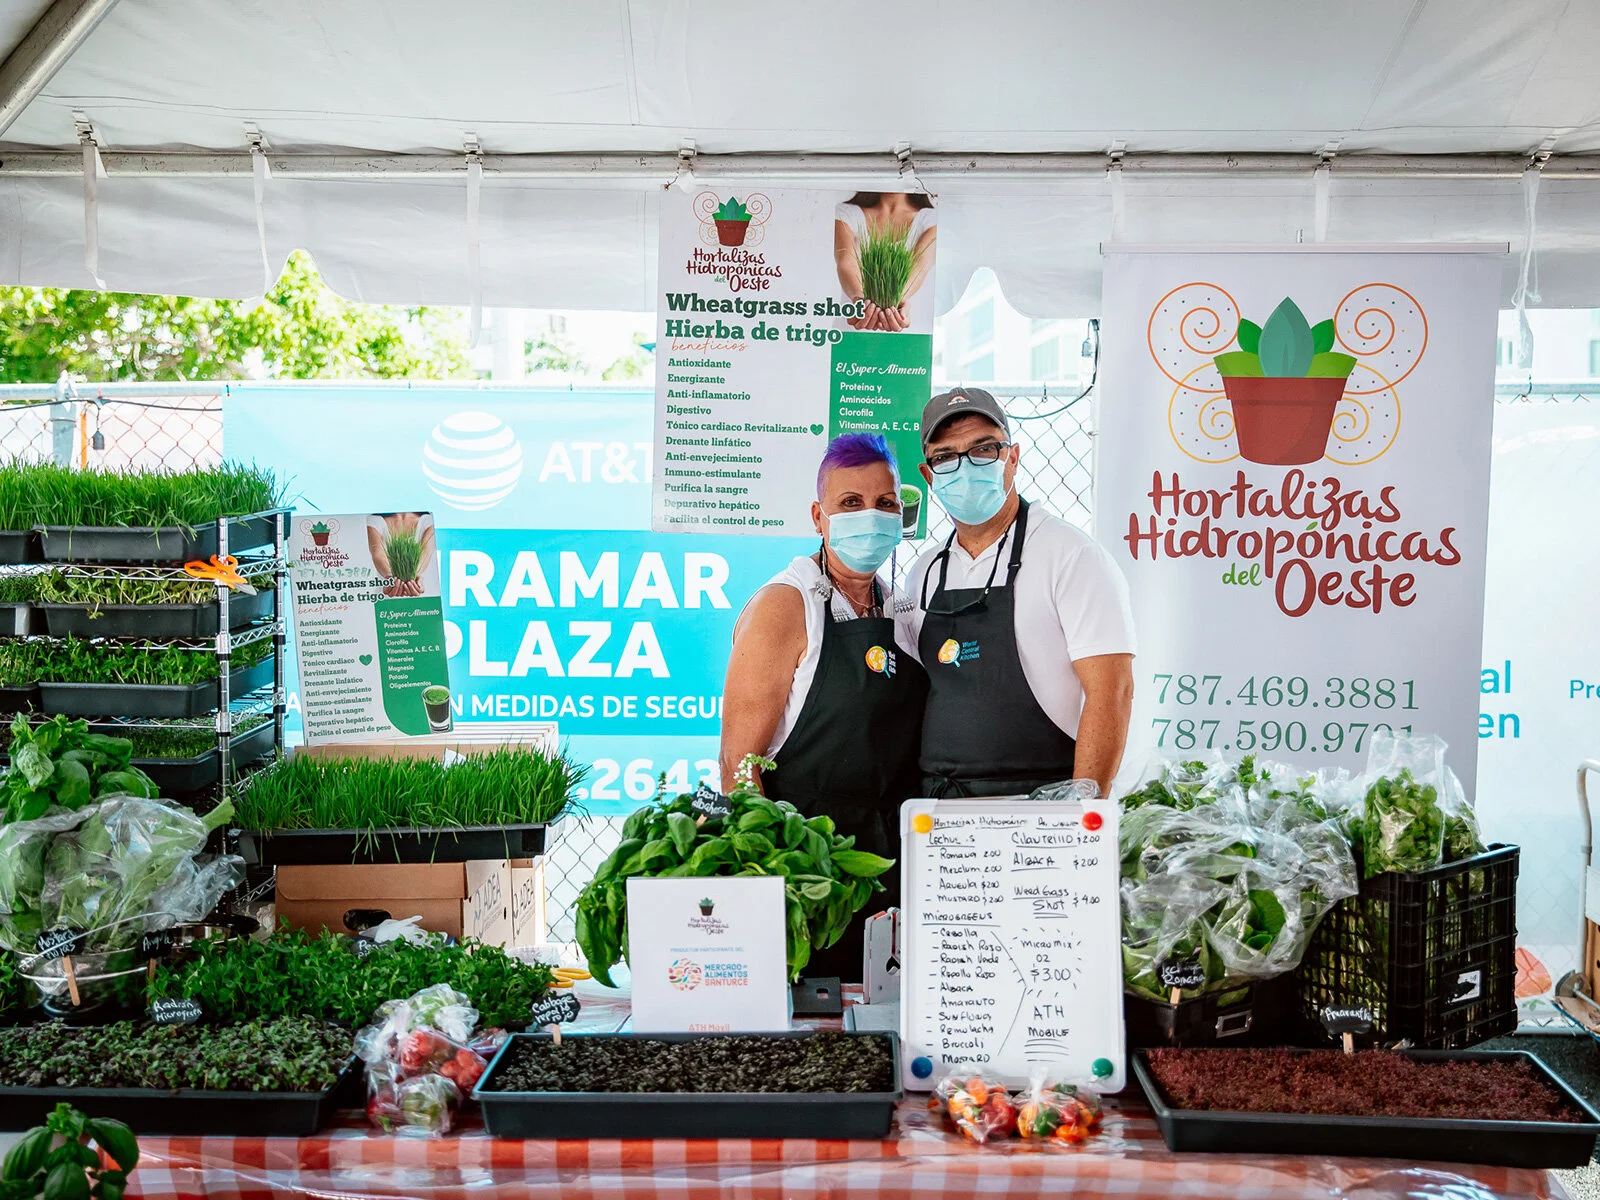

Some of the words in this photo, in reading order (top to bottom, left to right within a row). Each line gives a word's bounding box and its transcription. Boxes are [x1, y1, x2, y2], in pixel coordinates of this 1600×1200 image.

[693, 248, 765, 266] Hortalizas
[686, 260, 782, 280] Hidropónicas
[730, 275, 770, 293] Oeste
[666, 293, 808, 319] Wheatgrass
[814, 298, 864, 318] shot
[665, 319, 745, 340] Hierba
[751, 321, 780, 341] de
[786, 323, 843, 347] trigo
[671, 336, 748, 354] beneficios
[668, 358, 731, 369] Antioxidante
[836, 362, 846, 373] El
[846, 363, 877, 377] Super
[878, 364, 927, 375] Alimento
[668, 374, 726, 385] Energizante
[876, 384, 882, 393] y
[667, 390, 751, 401] Anti-inflamatorio
[840, 395, 891, 405] Aminoácidos
[666, 405, 712, 416] Digestivo
[840, 408, 873, 417] Clorofila
[666, 420, 699, 431] Tónico
[701, 422, 742, 432] cardiaco
[744, 424, 808, 434] Revitalizante
[839, 420, 879, 430] Vitaminas
[914, 422, 920, 431] B
[666, 437, 709, 447] Drenante
[712, 437, 751, 447] linfático
[538, 441, 653, 484] AT&T
[665, 452, 762, 464] Anti-envejecimiento
[665, 468, 761, 479] Inmuno-estimulante
[664, 484, 701, 493] Purifica
[704, 484, 713, 493] la
[715, 486, 748, 496] sangre
[1148, 468, 1401, 531] Hortalizas
[664, 499, 717, 509] Depurativo
[719, 500, 760, 512] hepático
[664, 514, 699, 524] Facilita
[702, 515, 711, 524] el
[712, 516, 746, 526] control
[748, 517, 760, 526] de
[762, 518, 784, 528] peso
[1124, 512, 1461, 579] Hidropónicas
[296, 581, 366, 592] Wheatgrass
[369, 577, 394, 587] shot
[437, 550, 732, 609] RAMAR
[1222, 563, 1262, 587] del
[1274, 558, 1417, 618] Oeste
[298, 593, 338, 605] Hierba
[340, 592, 354, 603] de
[357, 591, 385, 605] trigo
[380, 611, 387, 619] El
[300, 618, 343, 627] Antioxidante
[300, 629, 340, 638] Energizante
[301, 637, 359, 647] Anti-inflamatorio
[302, 650, 333, 658] Digestivo
[303, 659, 326, 667] Tónico
[326, 658, 355, 666] cardiaco
[304, 668, 348, 677] Revitalizante
[304, 679, 335, 687] Drenante
[390, 681, 432, 689] Oligoelementos
[306, 687, 372, 698] Anti-envejecimiento
[1152, 673, 1419, 710] 787.469.3881
[306, 696, 373, 707] Inmuno-estimulante
[472, 694, 595, 718] MEDIDAS
[602, 696, 638, 718] DE
[307, 710, 333, 718] Purifica
[342, 708, 365, 716] sangre
[308, 719, 345, 728] Depurativo
[342, 726, 366, 735] control
[367, 725, 375, 733] de
[376, 724, 392, 733] peso
[704, 970, 748, 978] ALIMENTOS
[704, 978, 748, 986] SANTURCE
[1034, 1004, 1065, 1020] ATH
